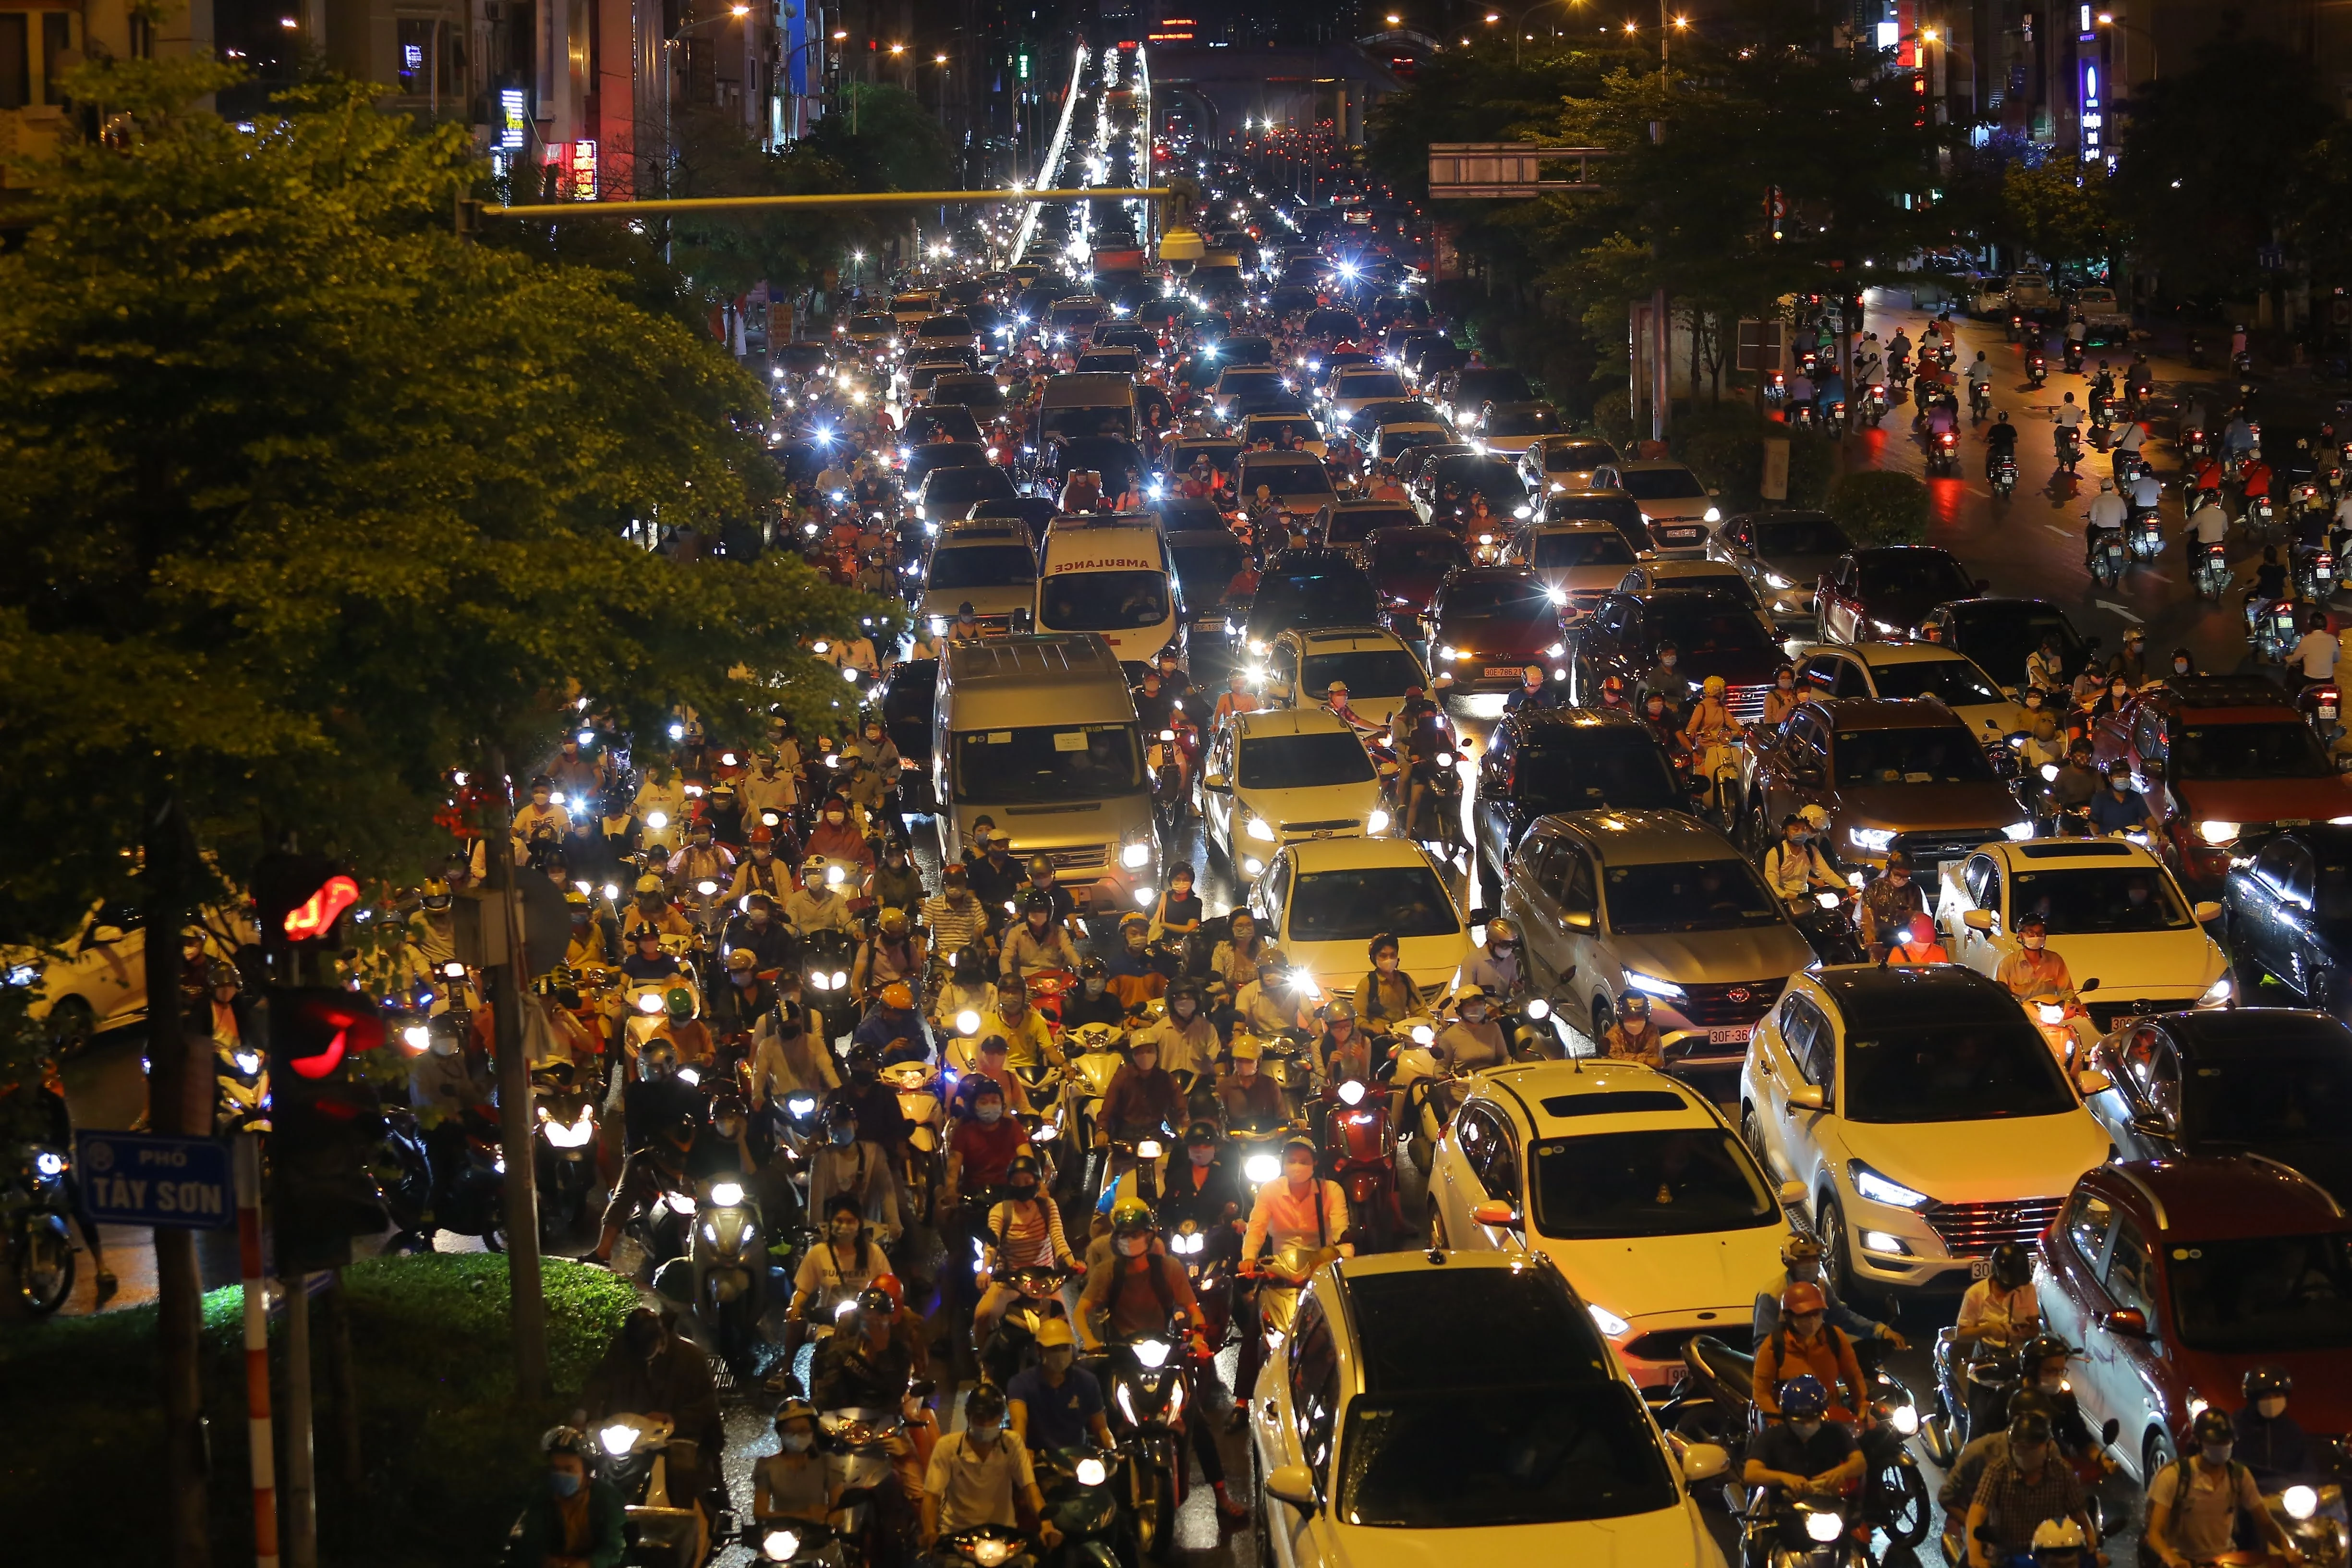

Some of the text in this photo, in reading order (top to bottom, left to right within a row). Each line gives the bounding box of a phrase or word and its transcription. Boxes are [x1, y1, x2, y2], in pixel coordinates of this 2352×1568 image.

[139, 1145, 188, 1167] PHỐ
[93, 1172, 222, 1215] TÂY SƠN
